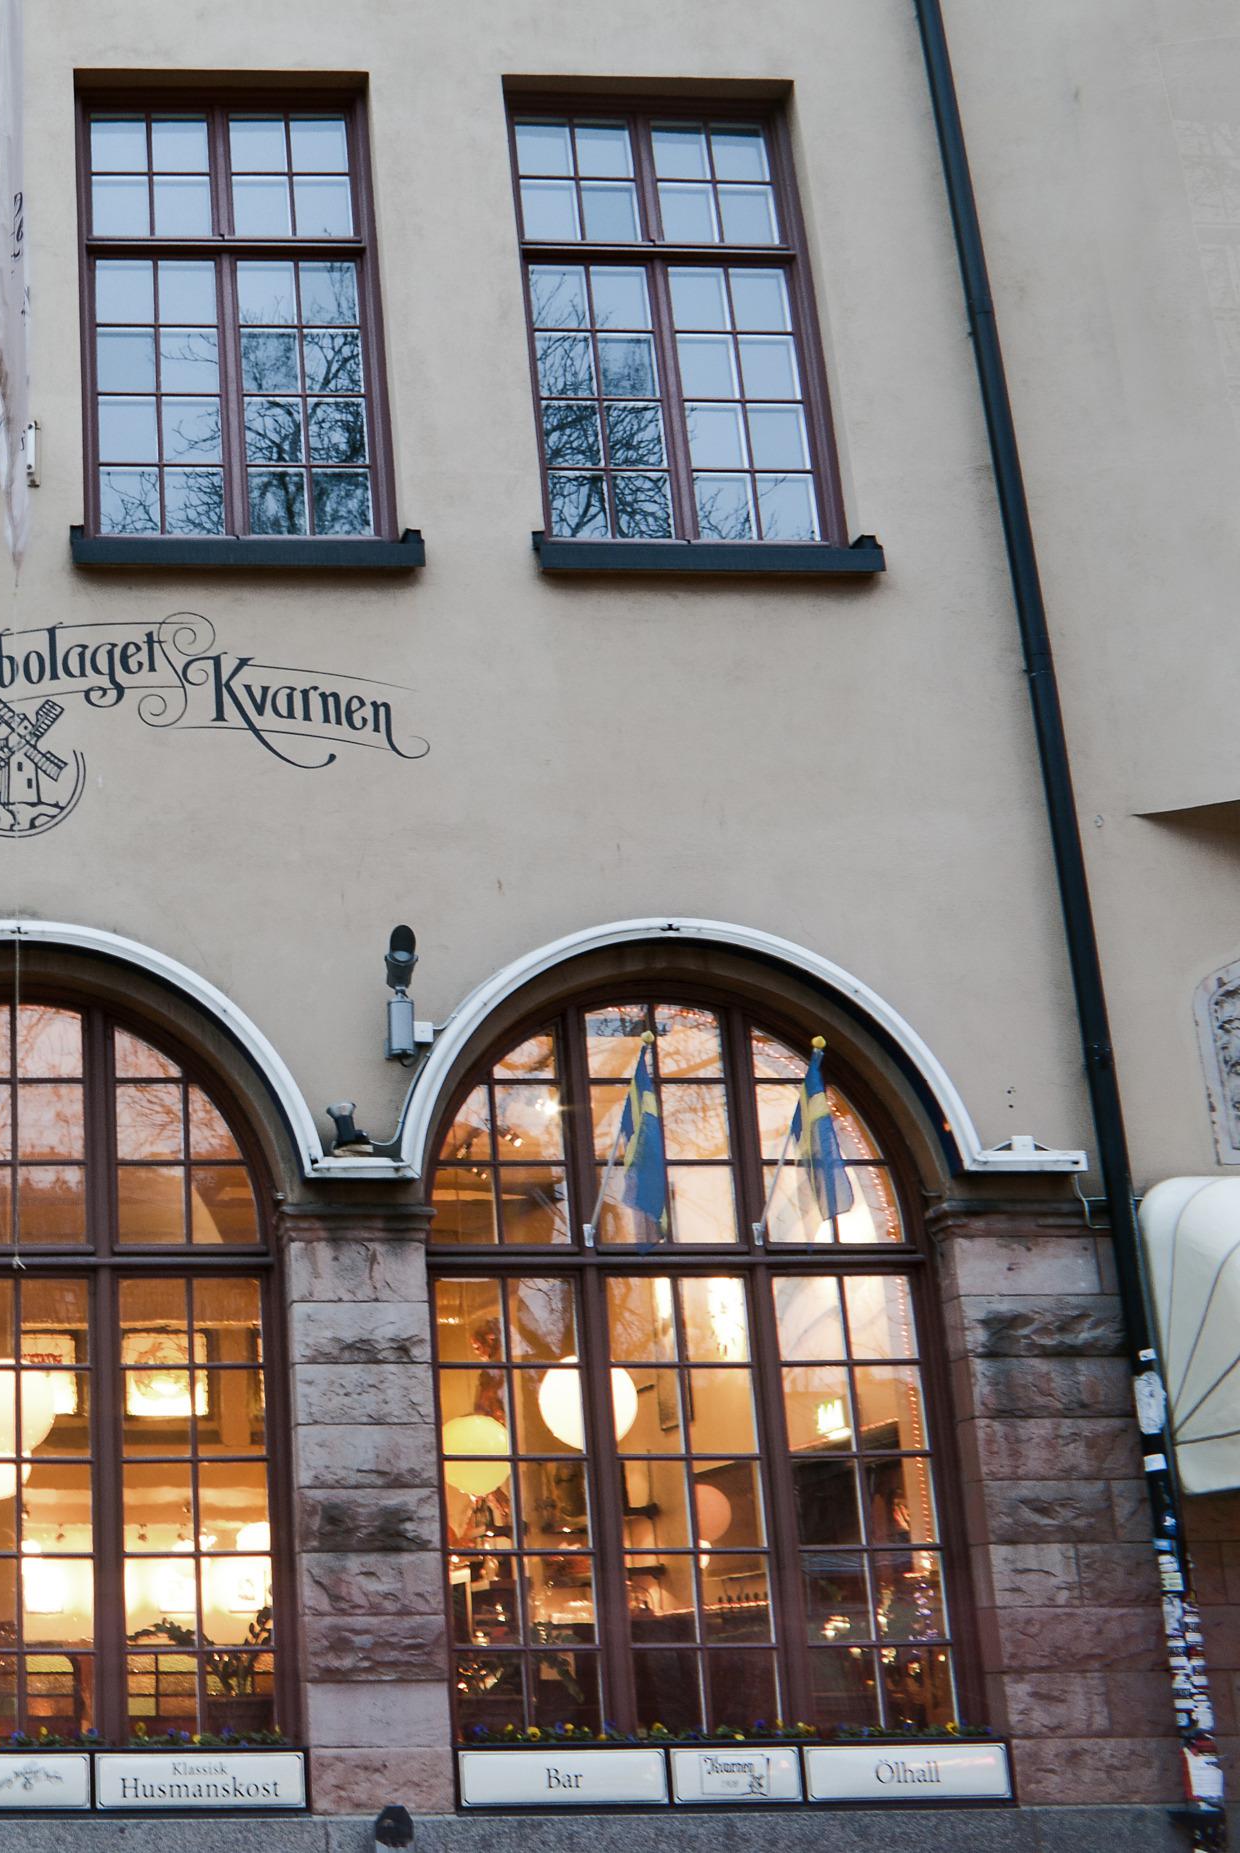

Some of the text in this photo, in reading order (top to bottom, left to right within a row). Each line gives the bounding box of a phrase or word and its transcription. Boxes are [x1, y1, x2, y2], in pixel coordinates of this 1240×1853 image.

[181, 651, 430, 769] Kvarnen
[171, 1761, 229, 1777] Klassisk
[545, 1767, 583, 1789] Bar
[875, 1758, 942, 1784] Ölhall
[120, 1776, 280, 1799] Husmanskost
